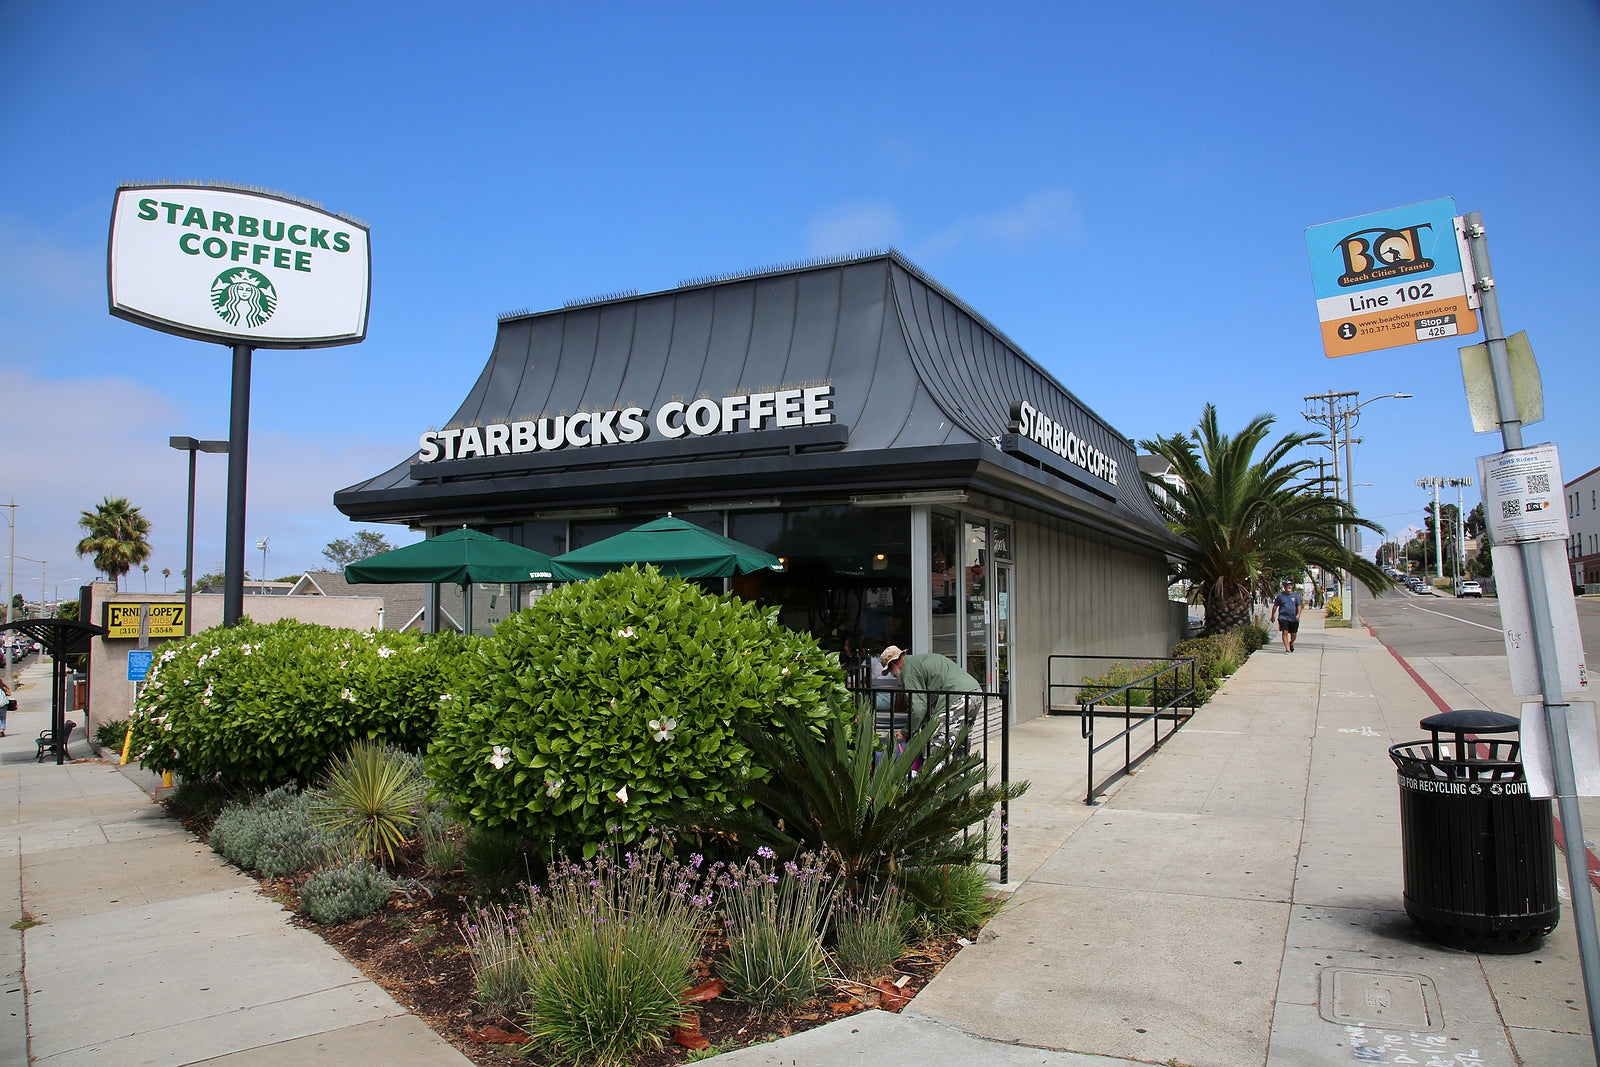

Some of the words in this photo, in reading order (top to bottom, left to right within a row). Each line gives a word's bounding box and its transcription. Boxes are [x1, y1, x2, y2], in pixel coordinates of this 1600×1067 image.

[138, 198, 350, 253] STARBUCKS
[179, 233, 312, 273] COFFEE
[1343, 274, 1369, 285] Beach
[1371, 268, 1397, 279] Cities
[1398, 261, 1430, 273] Transit
[1350, 294, 1389, 312] Line
[1396, 282, 1434, 303] 102
[1358, 304, 1458, 328] www.beachcitiestransit.org
[1420, 317, 1443, 328] Stop
[1360, 321, 1410, 336] 310.371.5200
[1428, 326, 1446, 337] 426
[418, 406, 648, 463] STARBUCKS
[656, 385, 834, 439] COFFEE
[1018, 400, 1086, 469] STARBUCKS
[1087, 444, 1118, 486] COFFEE
[110, 607, 140, 627] ERNI
[149, 617, 172, 625] ONDS!
[1406, 777, 1418, 790] FOR
[1419, 780, 1467, 796] RECYCLING
[1505, 782, 1530, 796] CONT
